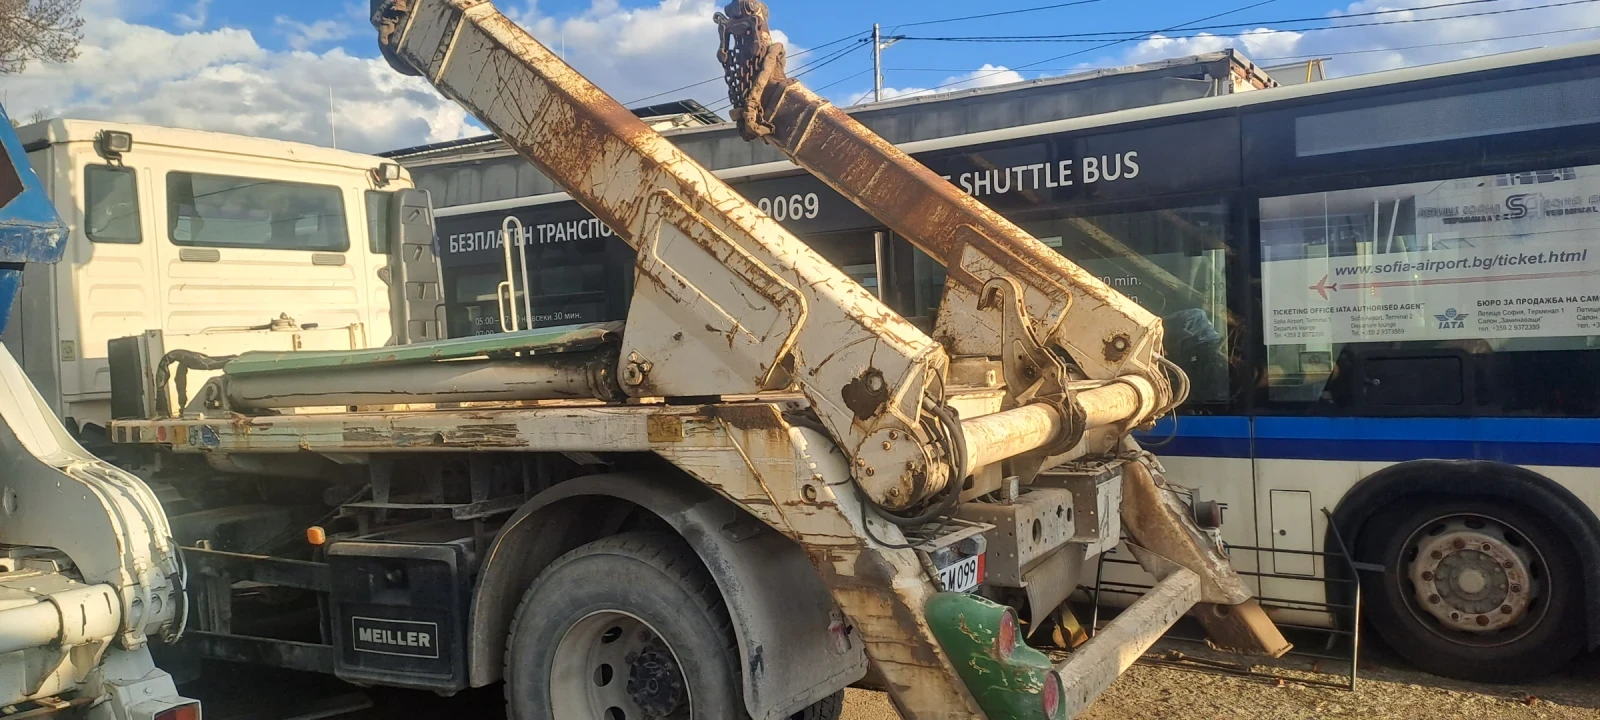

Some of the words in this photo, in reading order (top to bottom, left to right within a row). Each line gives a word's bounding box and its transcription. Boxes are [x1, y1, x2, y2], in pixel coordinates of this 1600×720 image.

[959, 159, 1073, 196] SHUTTLE
[1083, 151, 1139, 184] BUS
[757, 192, 819, 222] 9069
[536, 218, 618, 244] ТРАНСПО
[1335, 248, 1587, 276] www.sofia-airport.bg/ticket.html
[1516, 297, 1564, 306] ПРОДАЖБА
[1580, 295, 1600, 303] САМ
[1273, 308, 1308, 316] TICKETING
[1310, 306, 1335, 314] OFFICE
[1352, 304, 1399, 312] AUTHORISED
[1527, 307, 1560, 315] Терминал
[475, 316, 494, 326] 05:00
[553, 312, 563, 320] 30
[1438, 321, 1465, 330] IATA
[359, 627, 431, 648] MEILLER
